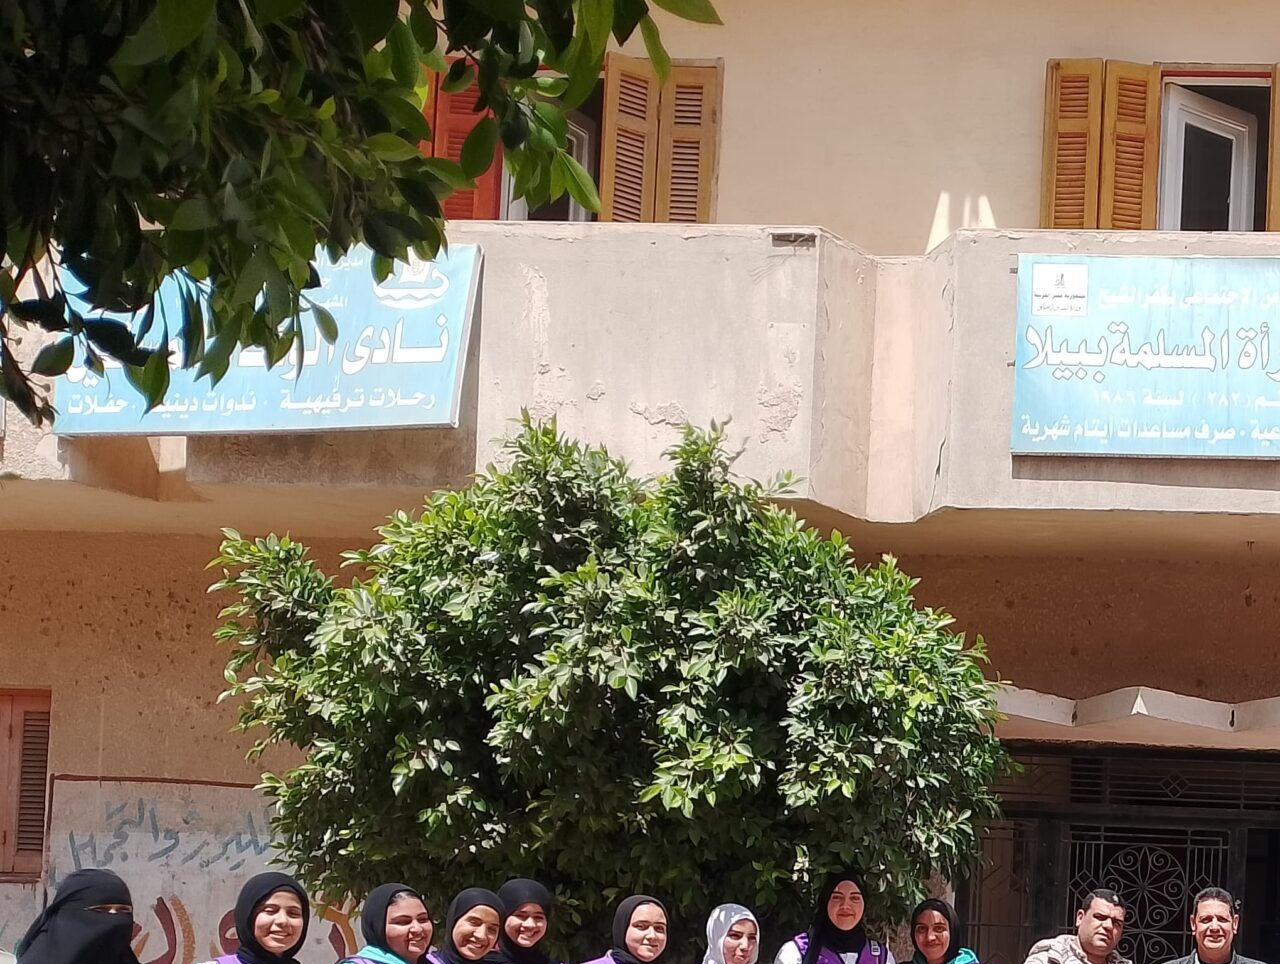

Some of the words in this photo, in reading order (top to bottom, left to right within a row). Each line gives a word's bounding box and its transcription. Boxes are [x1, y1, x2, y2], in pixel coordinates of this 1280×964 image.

[341, 314, 451, 376] نادى
[1022, 324, 1110, 383] ببيلا
[1108, 320, 1229, 372] المسلمة
[67, 394, 130, 416] حفلات
[151, 392, 199, 418] ديني
[201, 393, 258, 417] ندوات
[279, 387, 367, 416] ترفيهية
[367, 386, 437, 411] رحلات
[1142, 387, 1185, 406] لسنة
[1021, 413, 1072, 443] شهرية
[1117, 417, 1193, 440] مساعدات
[1194, 417, 1236, 445] صرف
